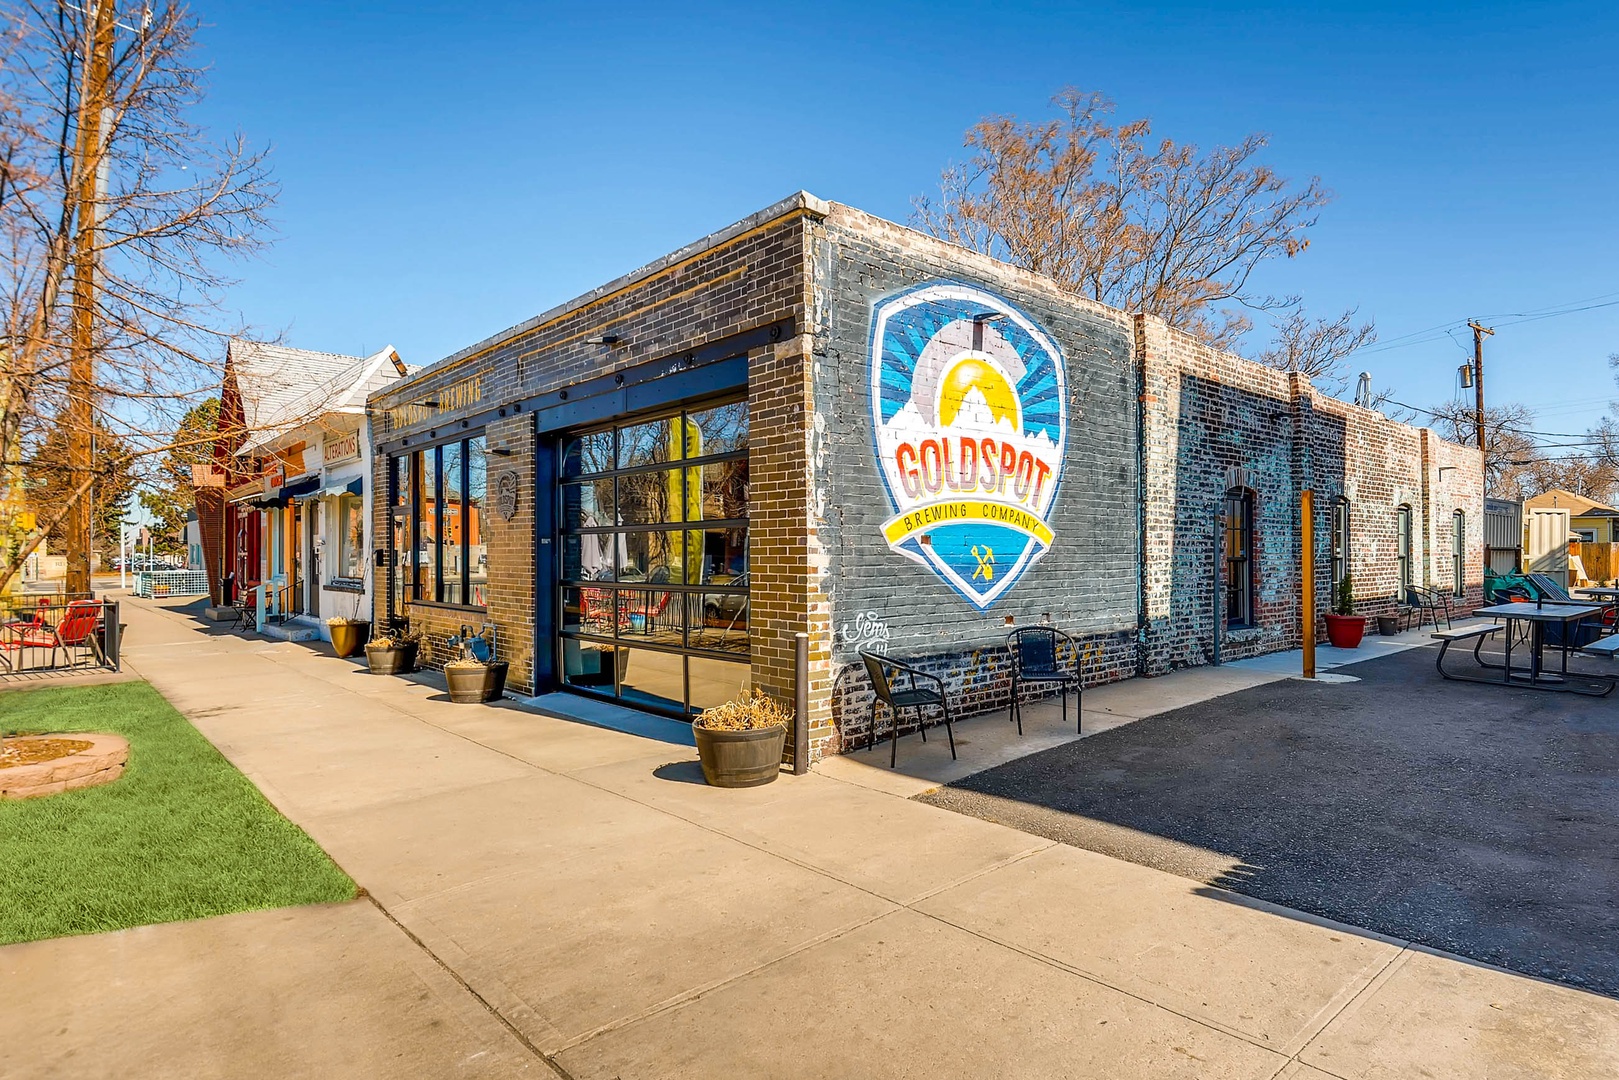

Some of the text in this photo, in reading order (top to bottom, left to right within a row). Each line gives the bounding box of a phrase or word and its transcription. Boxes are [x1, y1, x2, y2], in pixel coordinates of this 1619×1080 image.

[439, 377, 481, 415] BREWING
[323, 436, 356, 463] ALTERATIONS
[895, 436, 1052, 508] GOLDSPOT
[904, 504, 1039, 532] BREWING COMPANY
